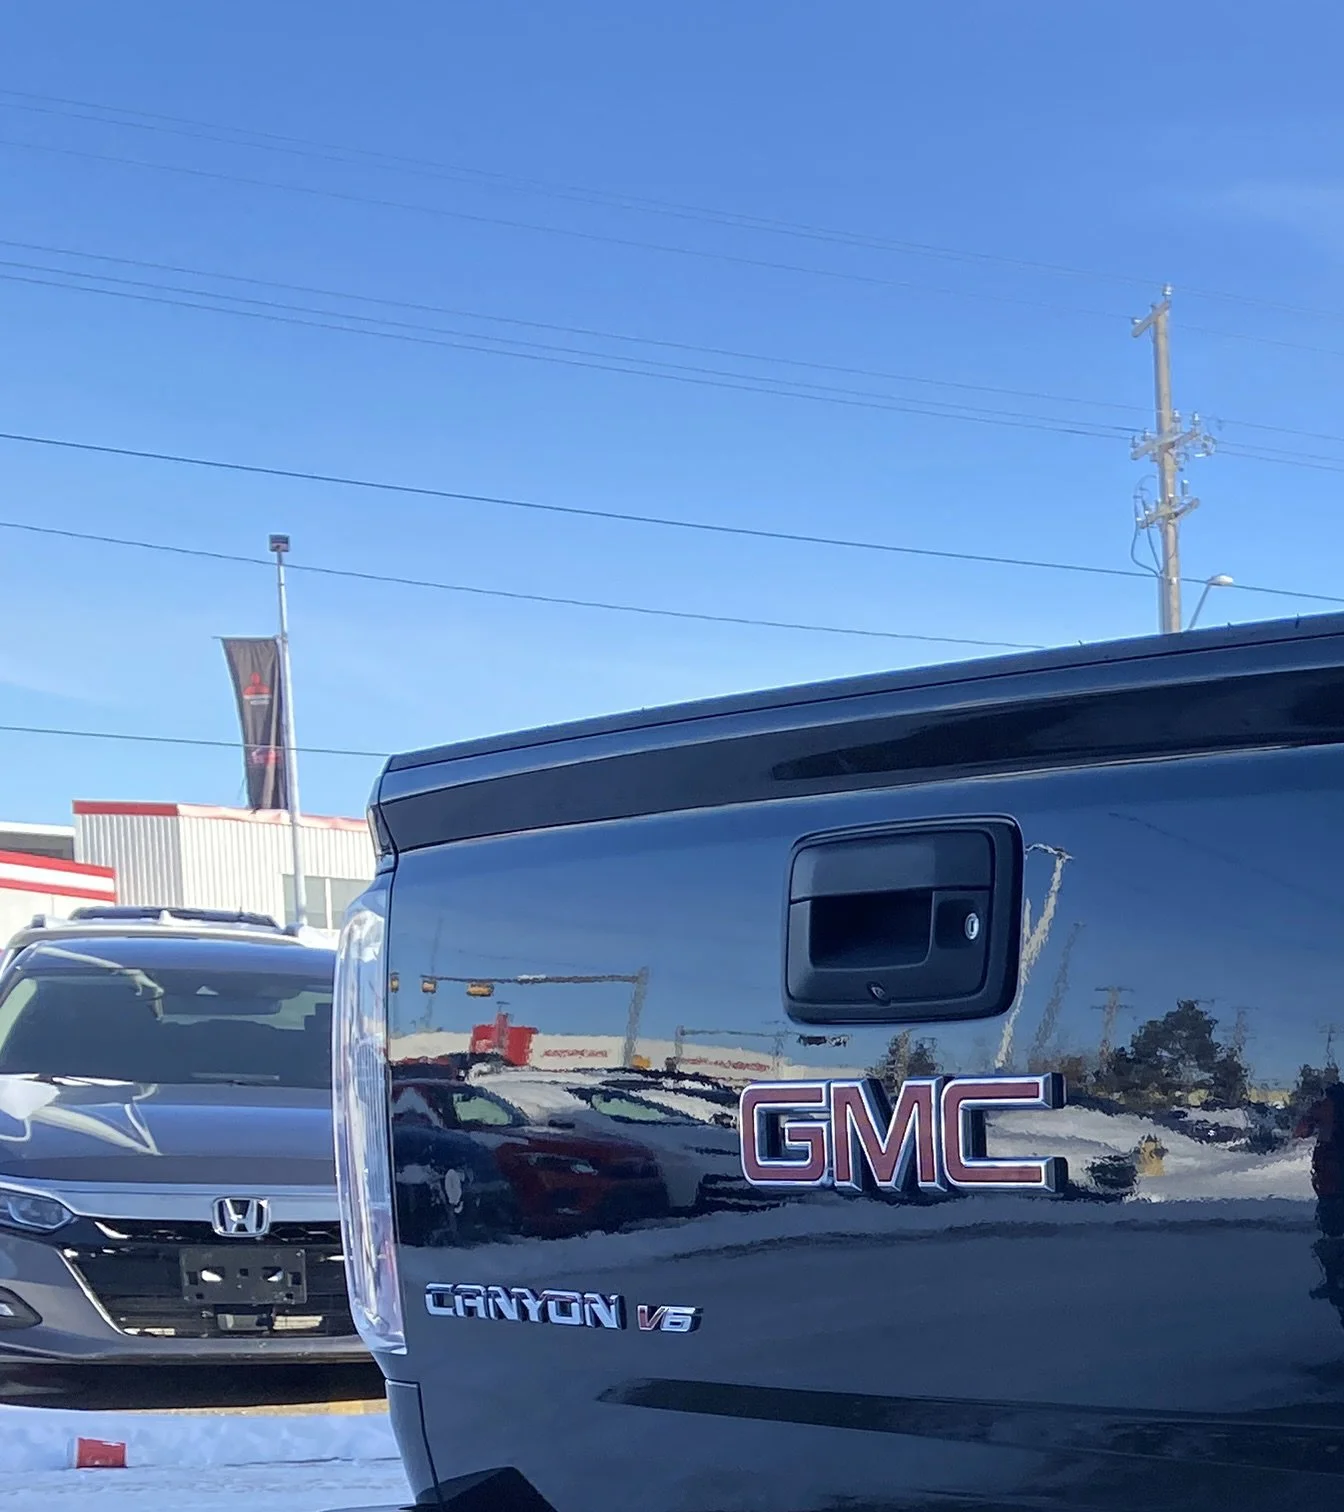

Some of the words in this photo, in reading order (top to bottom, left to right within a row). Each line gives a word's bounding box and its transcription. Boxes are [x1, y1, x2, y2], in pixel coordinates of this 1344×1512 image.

[739, 1072, 1067, 1193] GMC
[424, 1282, 627, 1330] CANYON
[636, 1305, 700, 1333] V6
